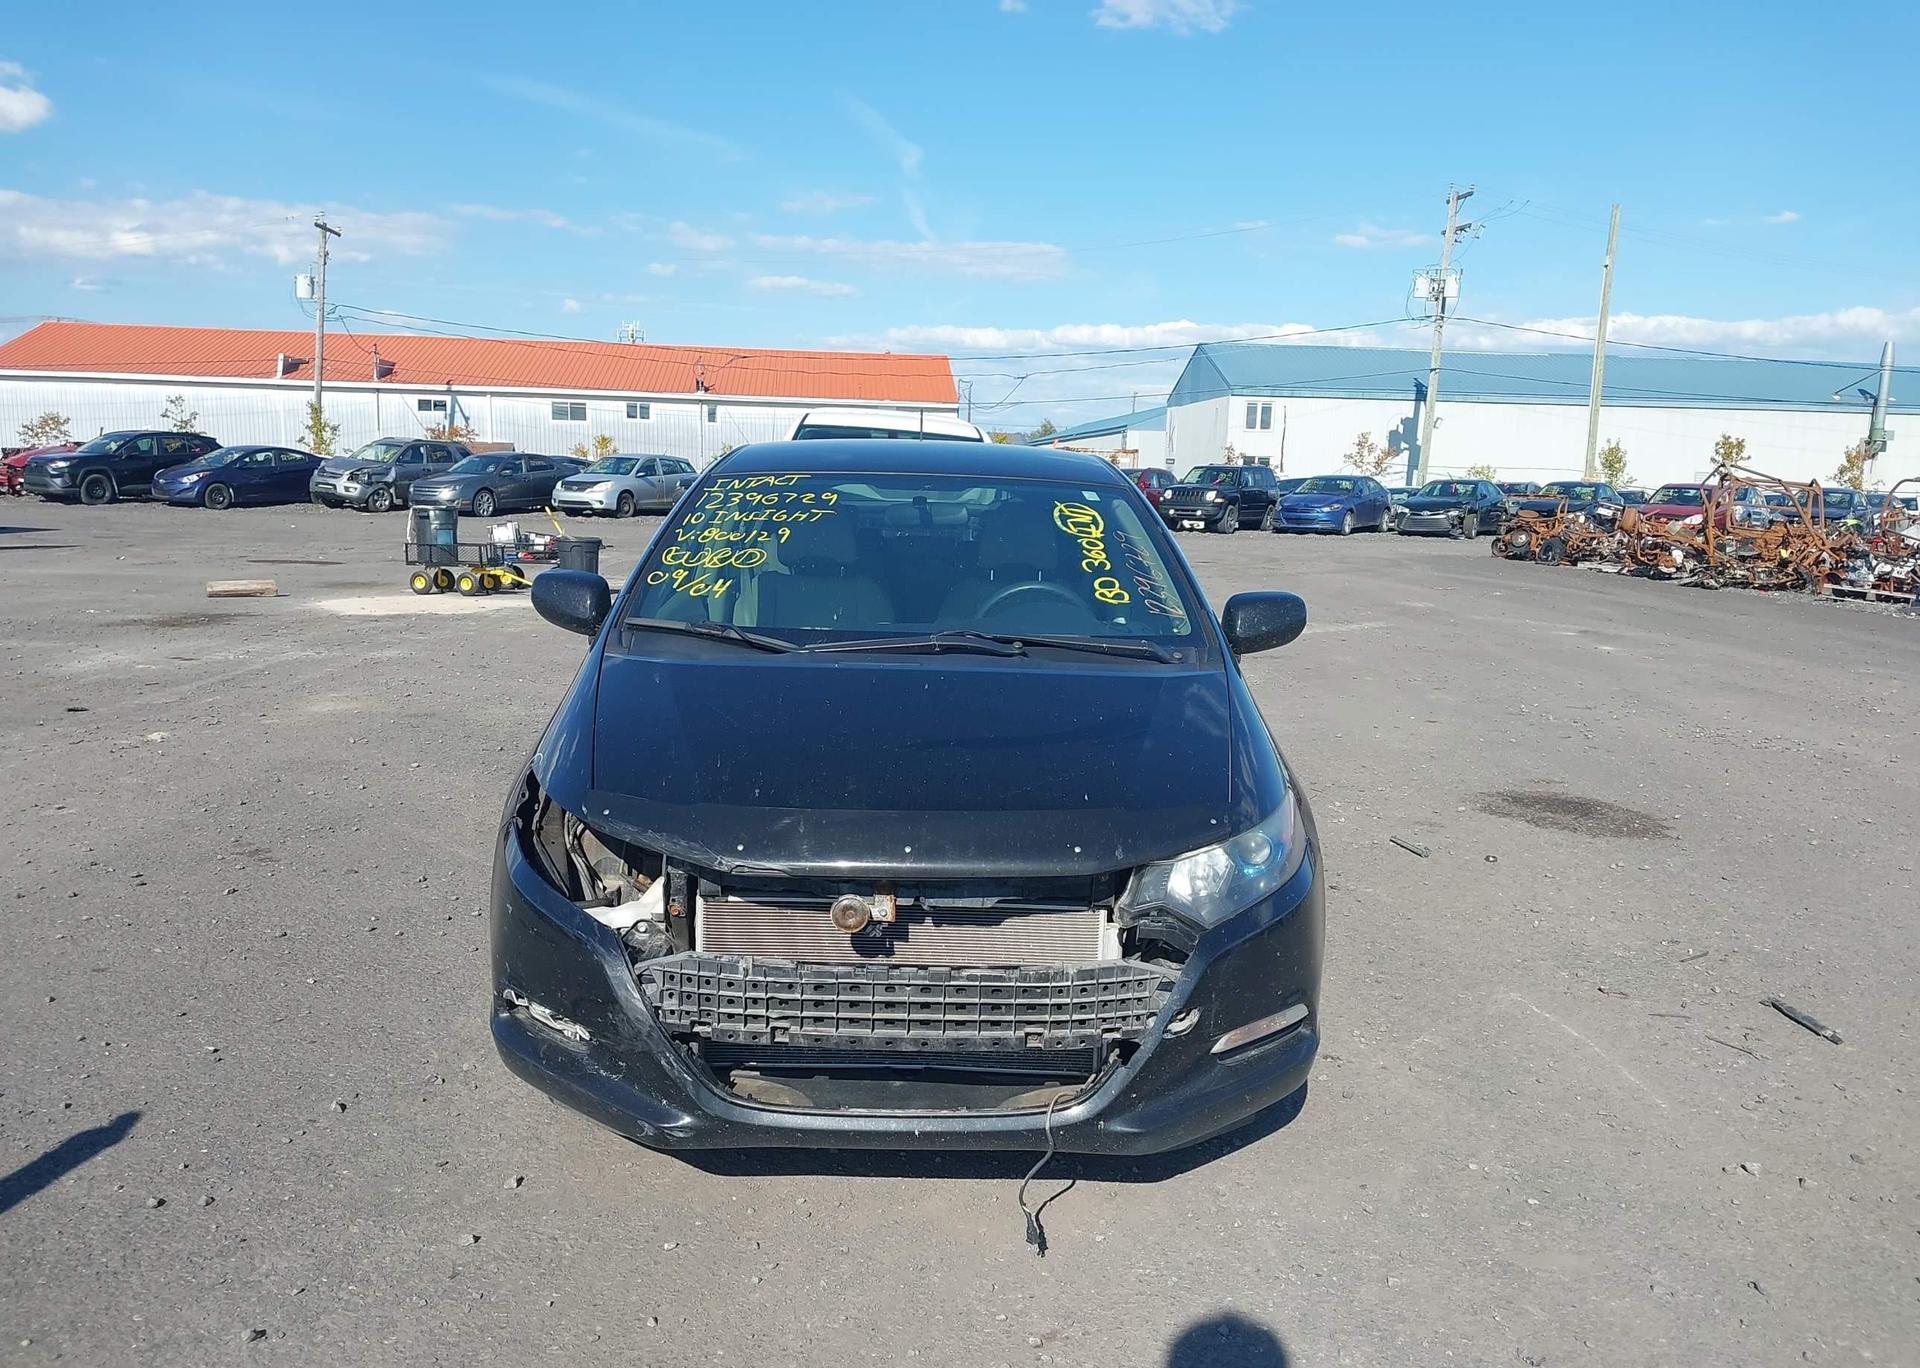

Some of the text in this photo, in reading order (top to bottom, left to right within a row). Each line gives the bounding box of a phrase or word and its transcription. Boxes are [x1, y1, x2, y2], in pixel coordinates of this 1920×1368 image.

[704, 475, 811, 491] INTACT
[695, 491, 838, 510] 12396729
[682, 509, 838, 526] 10 INSIGHT
[647, 569, 734, 598] 09/04
